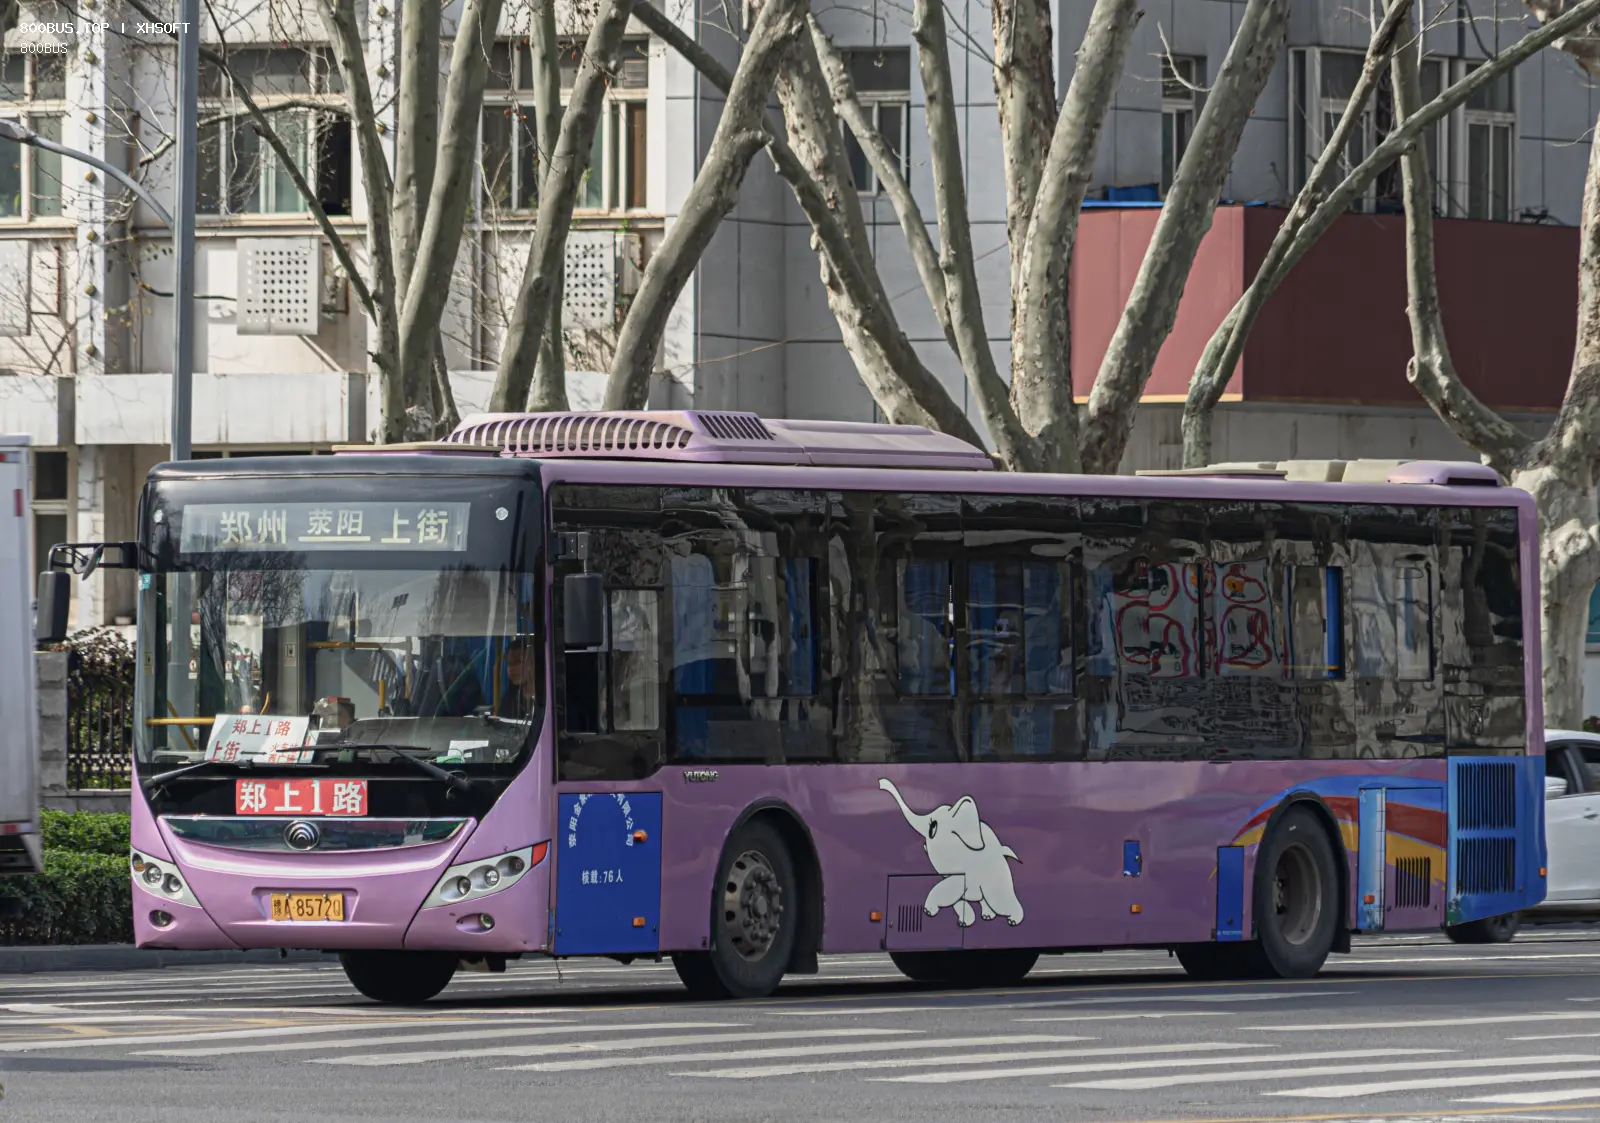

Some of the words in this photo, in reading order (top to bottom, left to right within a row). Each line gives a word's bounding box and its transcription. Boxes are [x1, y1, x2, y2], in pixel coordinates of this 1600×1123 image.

[220, 508, 288, 545] 郑州
[306, 507, 364, 536] 荥阳
[380, 508, 450, 545] 上街
[231, 718, 292, 737] 郑上1路
[208, 740, 242, 762] 上街
[239, 779, 363, 814] 郑上1路
